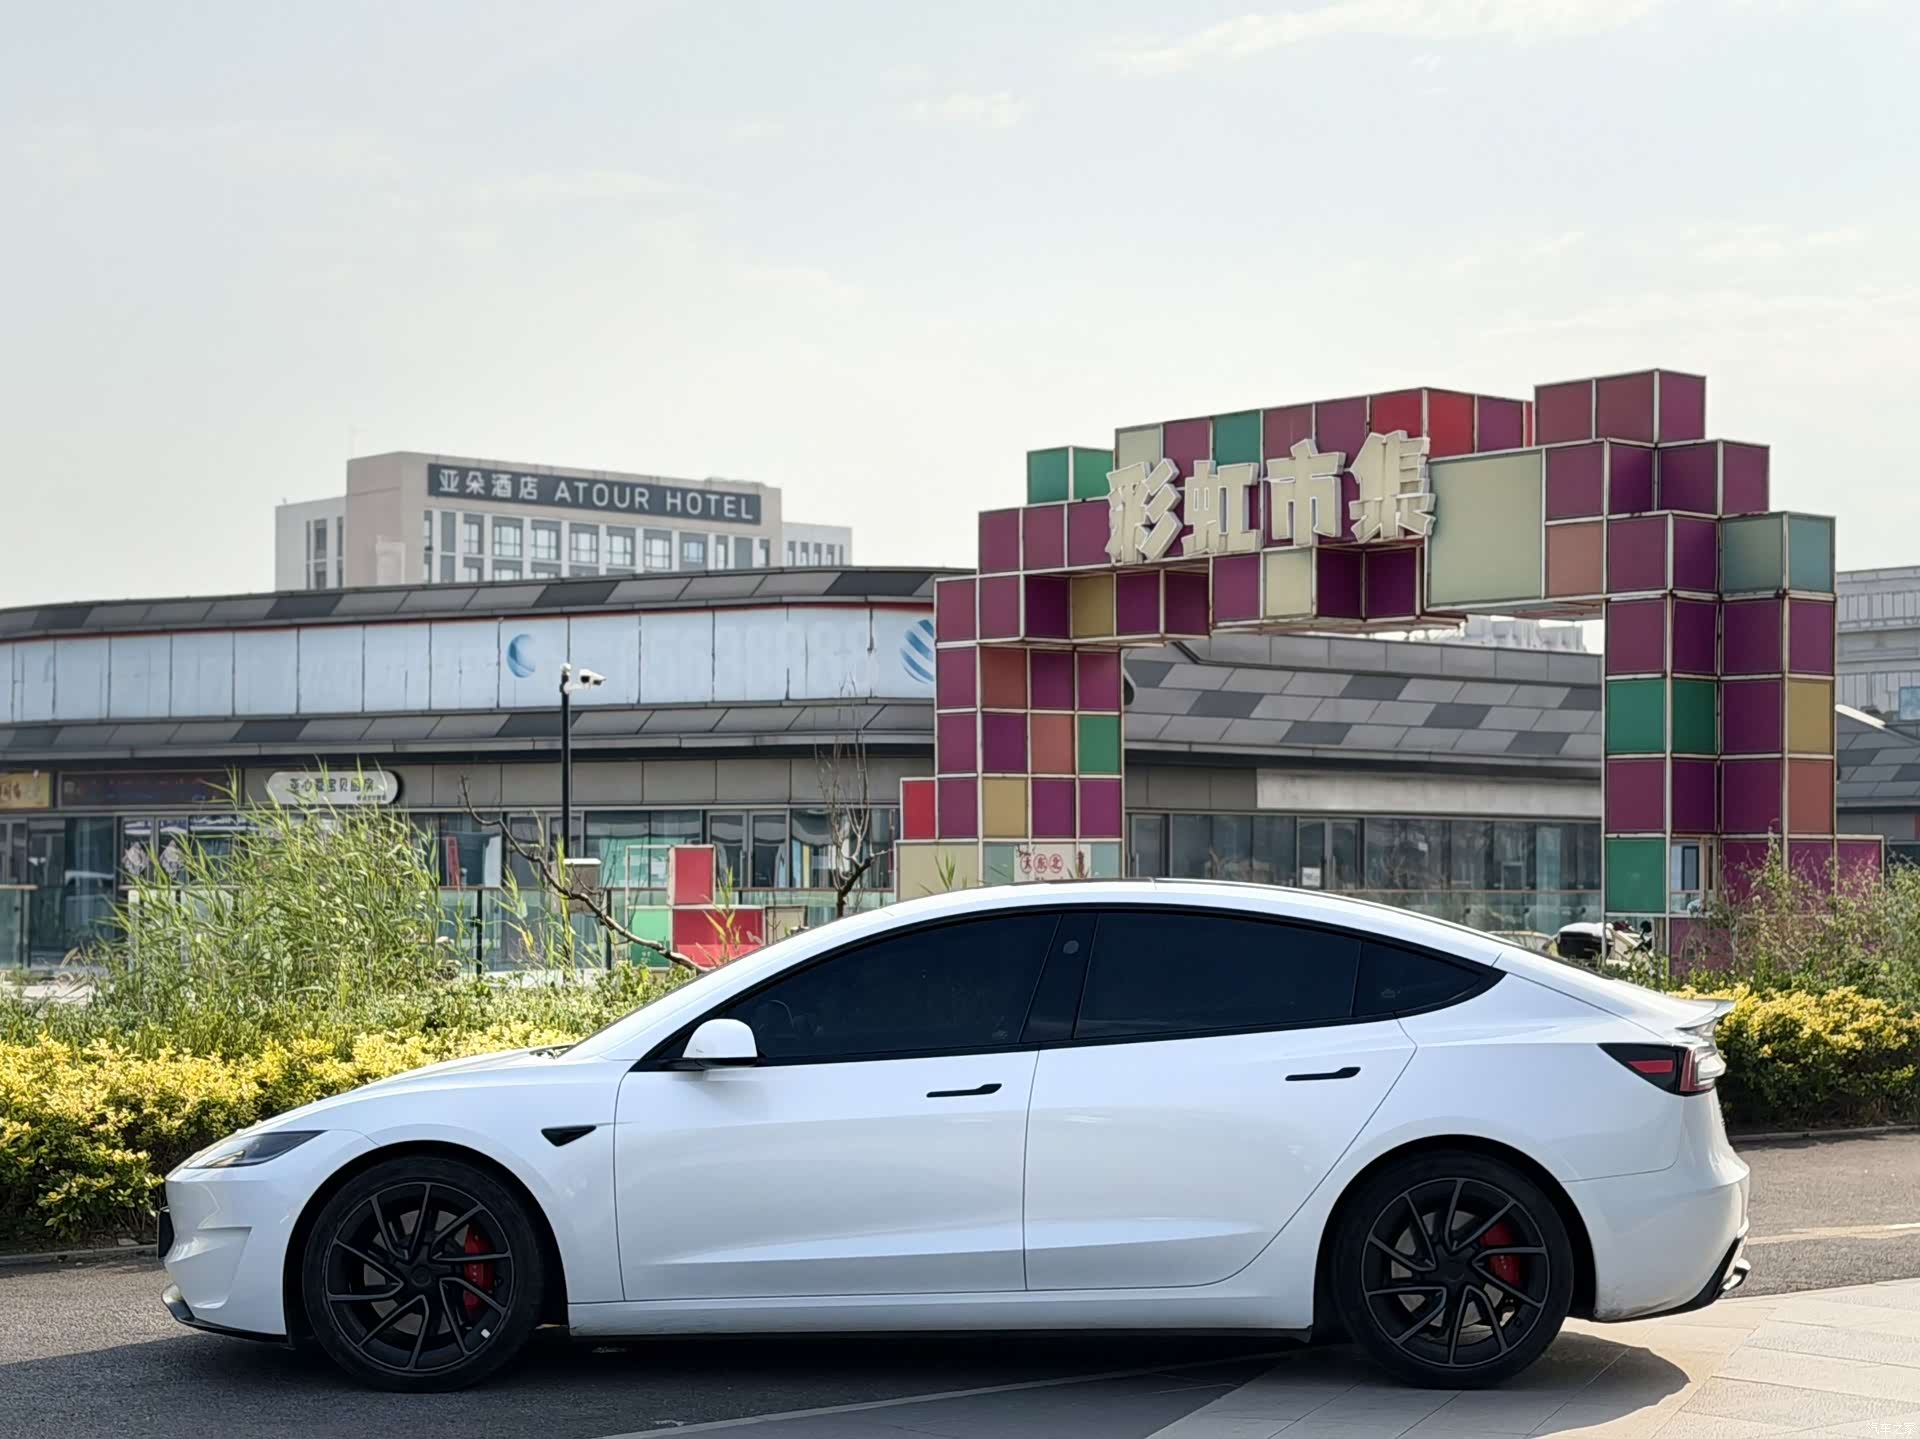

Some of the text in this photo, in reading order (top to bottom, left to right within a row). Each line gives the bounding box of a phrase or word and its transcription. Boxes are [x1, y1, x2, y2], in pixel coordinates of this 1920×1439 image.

[439, 468, 753, 520] 亚朵酒店 ATOUR HOTEL
[1105, 429, 1436, 565] 彩虹市集
